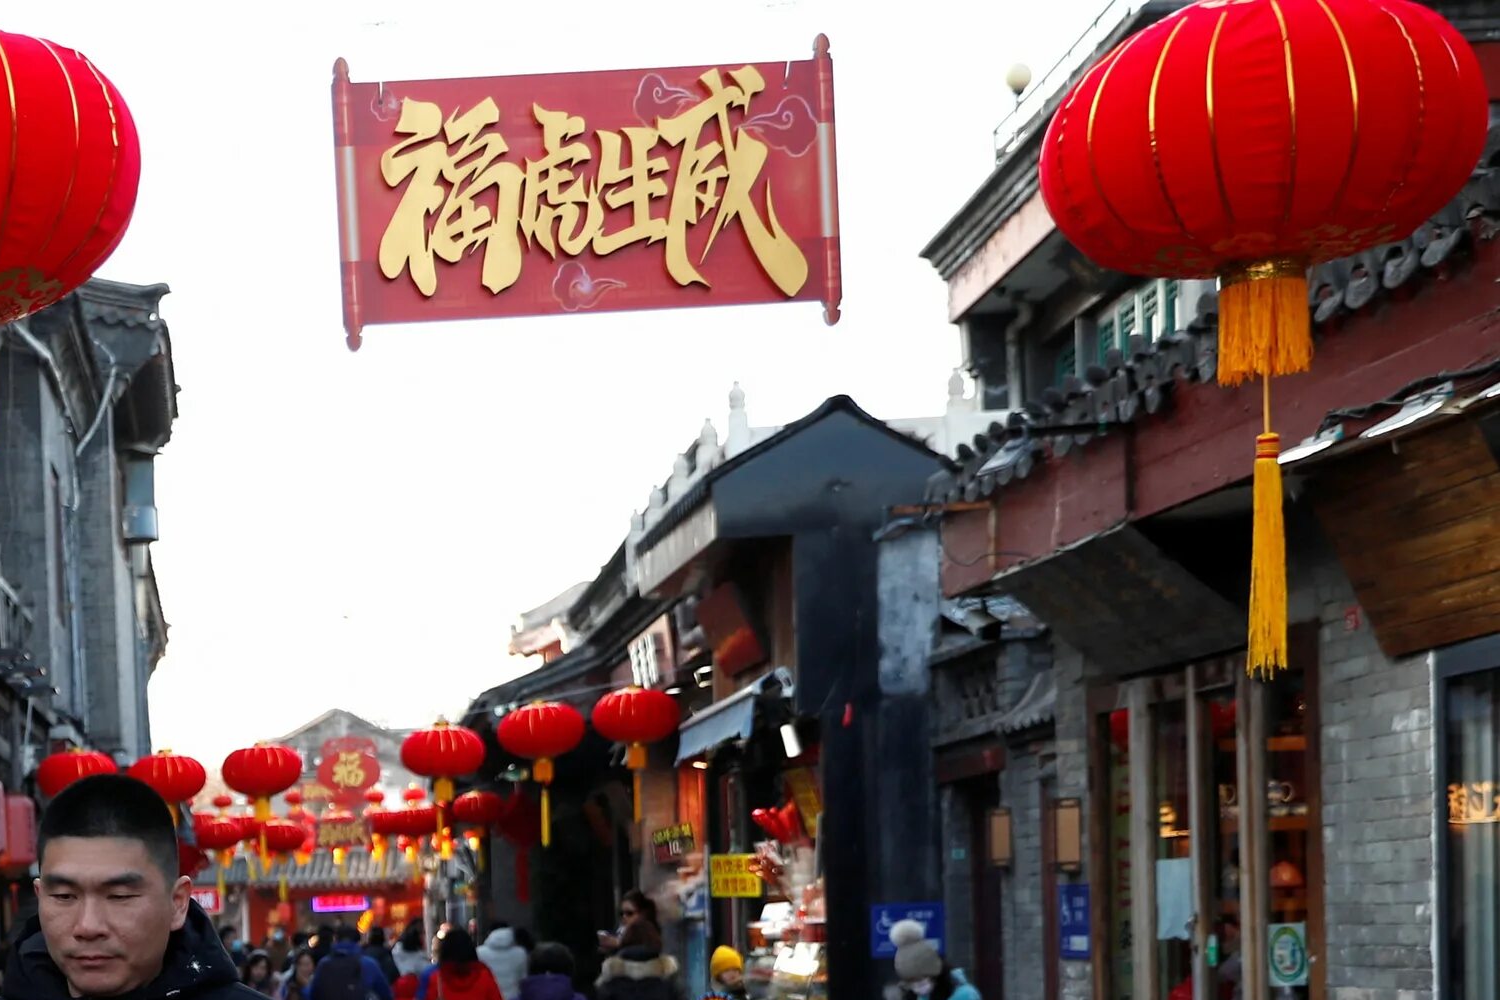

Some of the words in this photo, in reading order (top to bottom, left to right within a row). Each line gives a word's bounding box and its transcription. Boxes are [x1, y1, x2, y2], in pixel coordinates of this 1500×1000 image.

[379, 65, 809, 298] 福虎生威
[332, 752, 366, 788] 福
